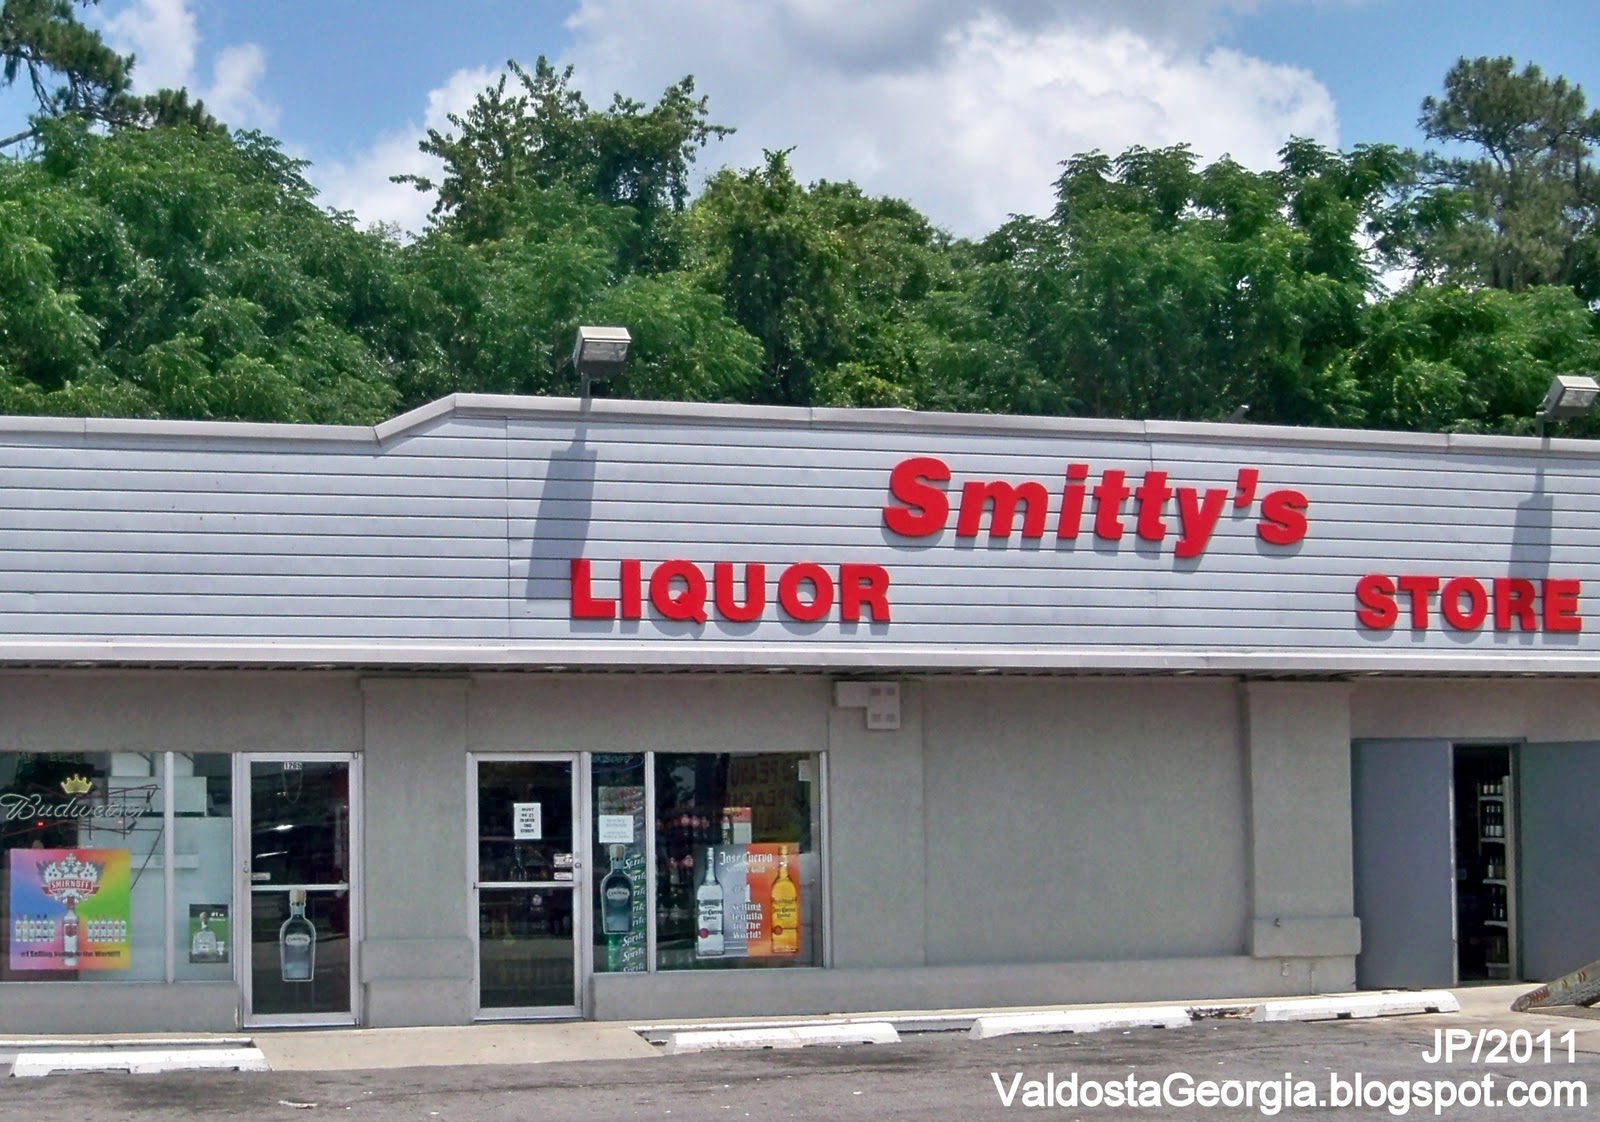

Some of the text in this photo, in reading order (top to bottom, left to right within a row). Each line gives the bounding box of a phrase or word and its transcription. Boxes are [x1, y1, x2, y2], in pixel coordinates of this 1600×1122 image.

[884, 457, 1309, 558] Smitty's
[571, 558, 1582, 633] LIQUOR STORE
[720, 851, 772, 865] Jose Cuervo
[51, 880, 90, 889] SMIRNOFF
